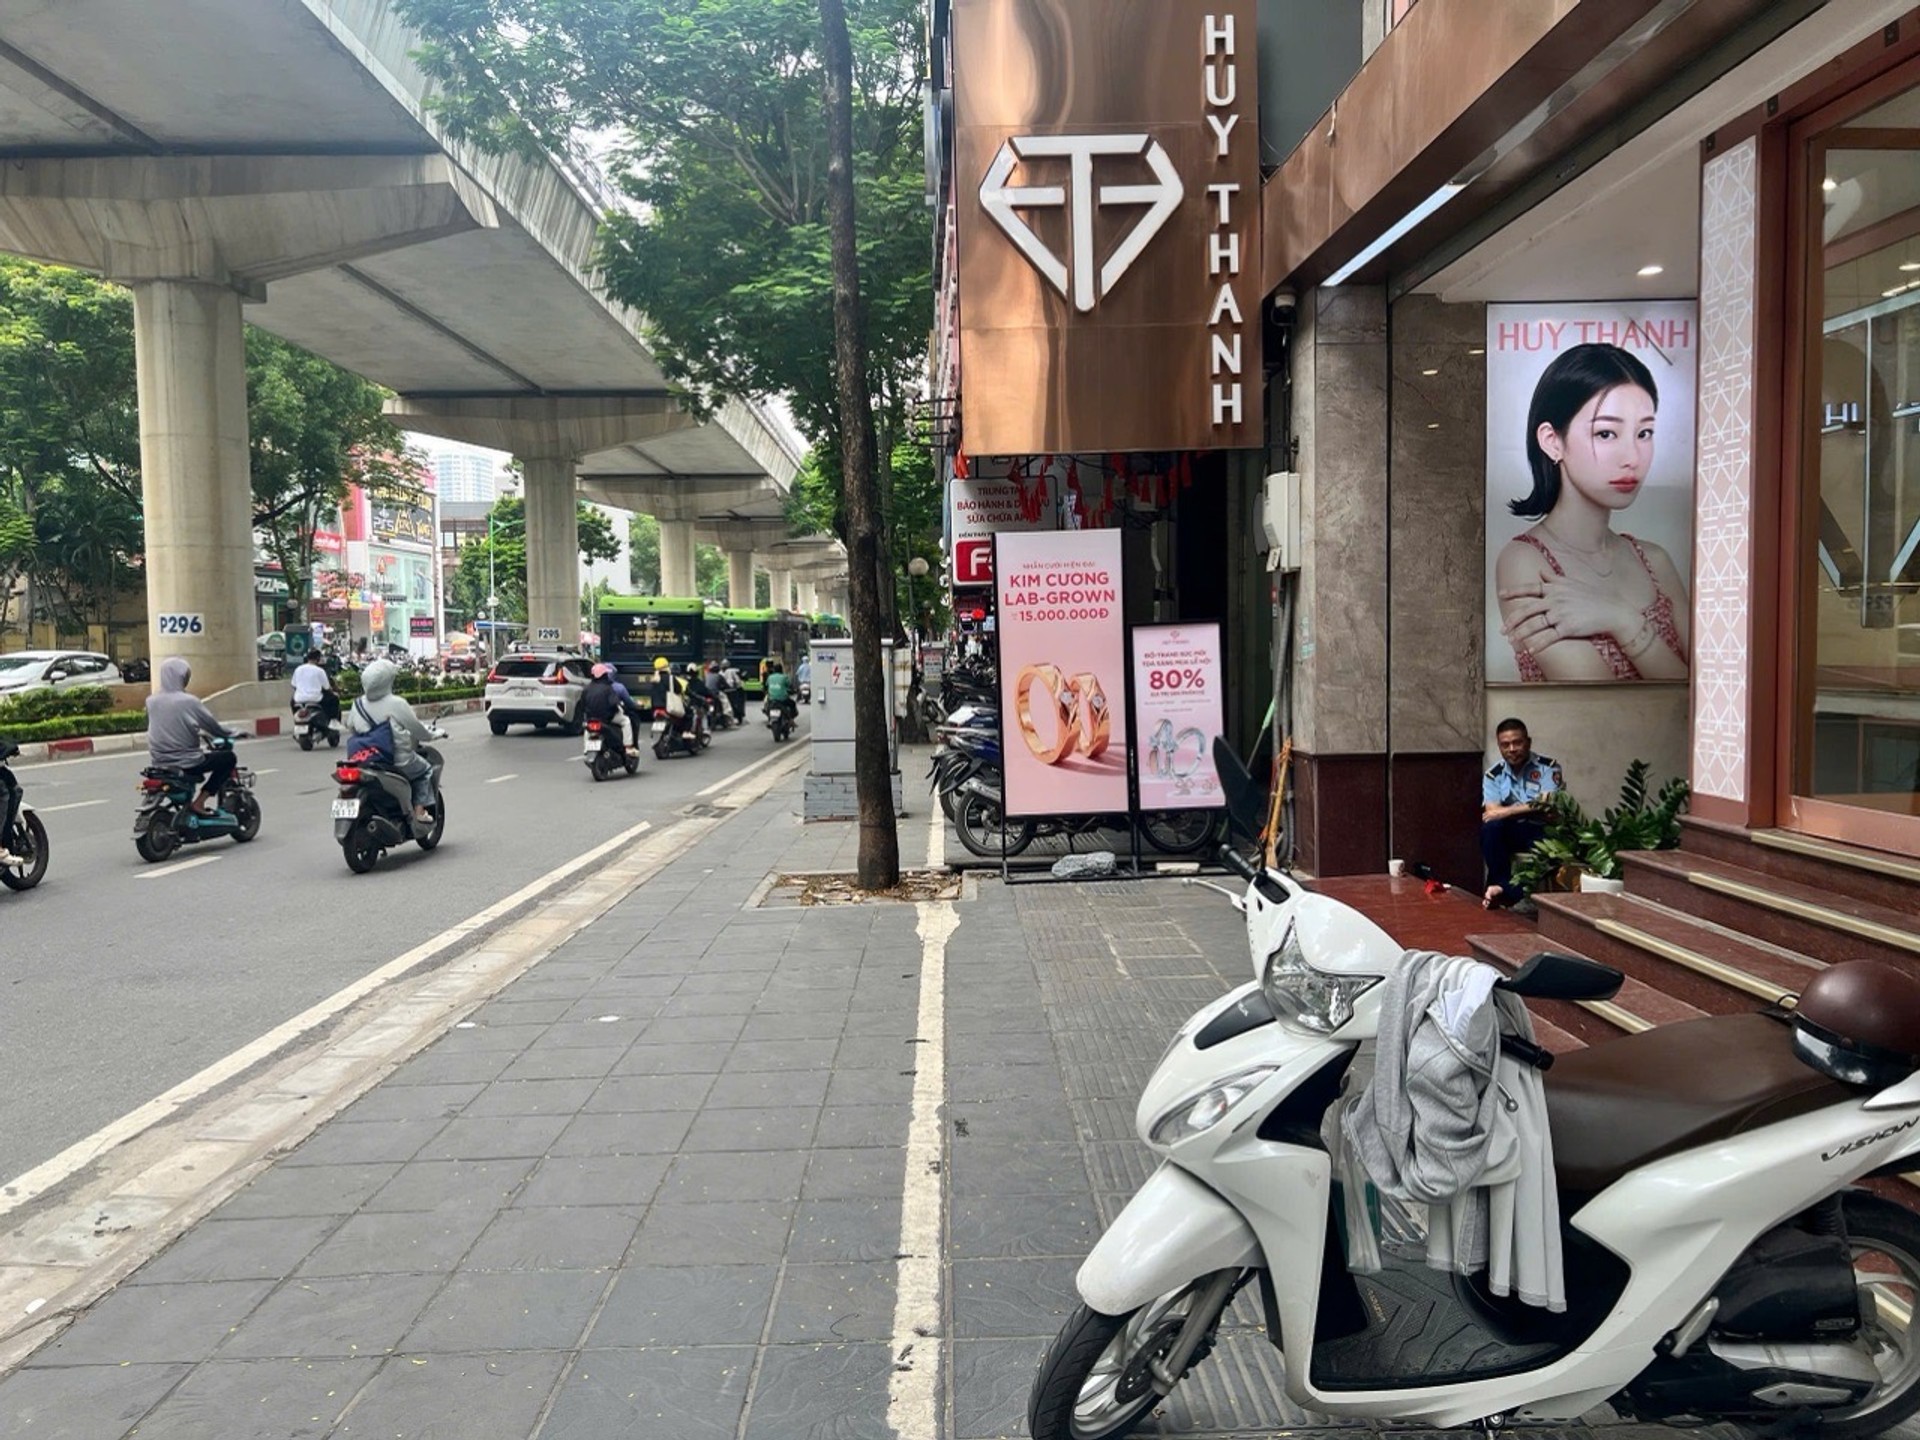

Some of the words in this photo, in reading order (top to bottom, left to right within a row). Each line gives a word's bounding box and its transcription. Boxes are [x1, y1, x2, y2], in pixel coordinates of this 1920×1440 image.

[1205, 14, 1239, 156] HUY
[1207, 183, 1243, 425] THANH
[1499, 321, 1567, 351] HUY
[1573, 319, 1690, 349] THANH
[977, 486, 1009, 496] TRUNG
[1010, 573, 1041, 588] KIM
[1004, 589, 1116, 607] LAB-GROWN
[1020, 607, 1109, 622] 15.000.000Đ
[160, 615, 202, 634] P296
[1150, 668, 1205, 690] 80%
